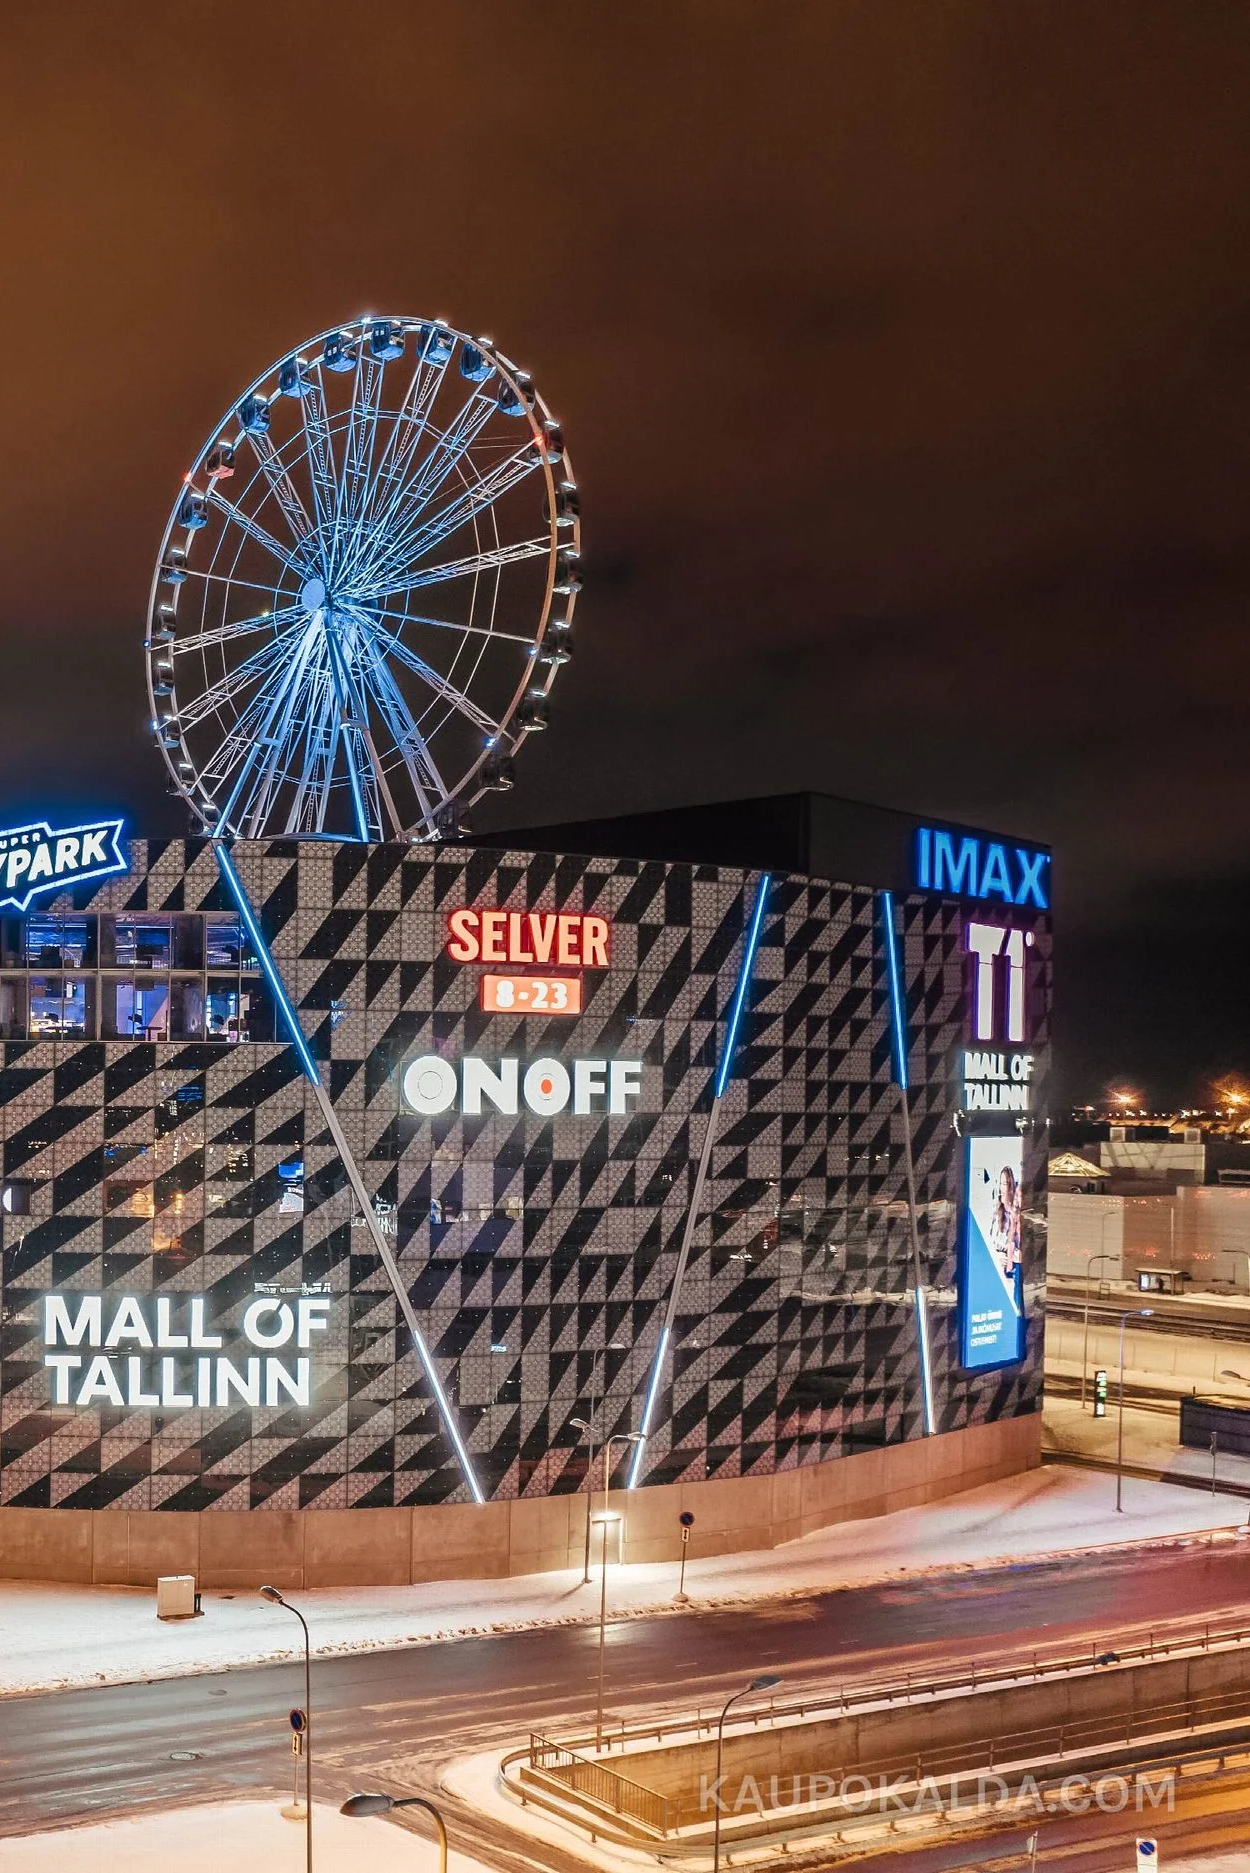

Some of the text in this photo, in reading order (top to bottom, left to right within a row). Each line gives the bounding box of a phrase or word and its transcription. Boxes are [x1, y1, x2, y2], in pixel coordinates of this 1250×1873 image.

[918, 827, 1048, 909] IMAX
[449, 909, 609, 966] SELVER
[495, 979, 568, 1009] 8-23
[403, 1055, 643, 1116] ONOFF
[964, 1052, 1035, 1081] MALL OF
[964, 1082, 1030, 1111] TALLINN
[44, 1295, 330, 1349] MALL OF
[44, 1355, 310, 1408] TALLINN
